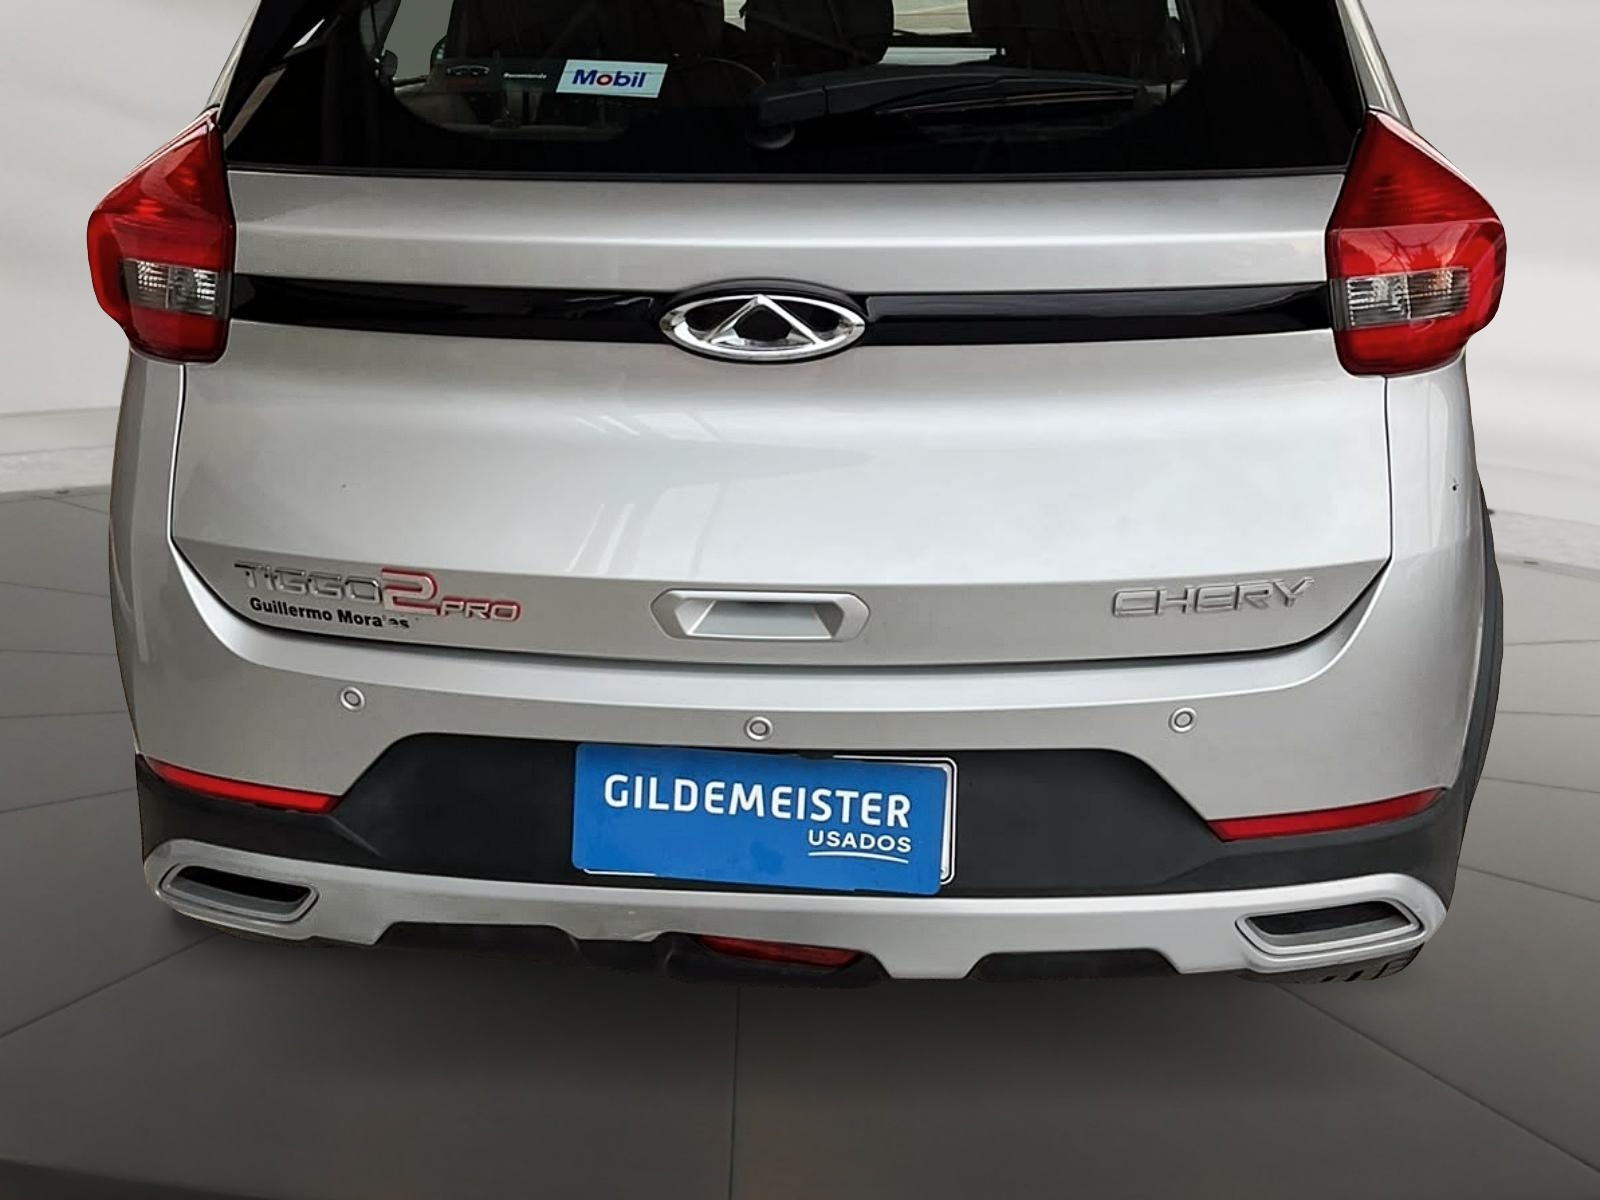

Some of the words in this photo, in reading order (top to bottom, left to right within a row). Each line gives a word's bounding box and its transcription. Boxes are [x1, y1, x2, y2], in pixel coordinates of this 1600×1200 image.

[572, 69, 646, 88] Mobil
[249, 596, 333, 622] Guillermo
[338, 609, 410, 629] Moraes
[1112, 576, 1315, 617] CHERY
[603, 773, 912, 829] GILDEMEISTER
[808, 829, 912, 853] USADOS
